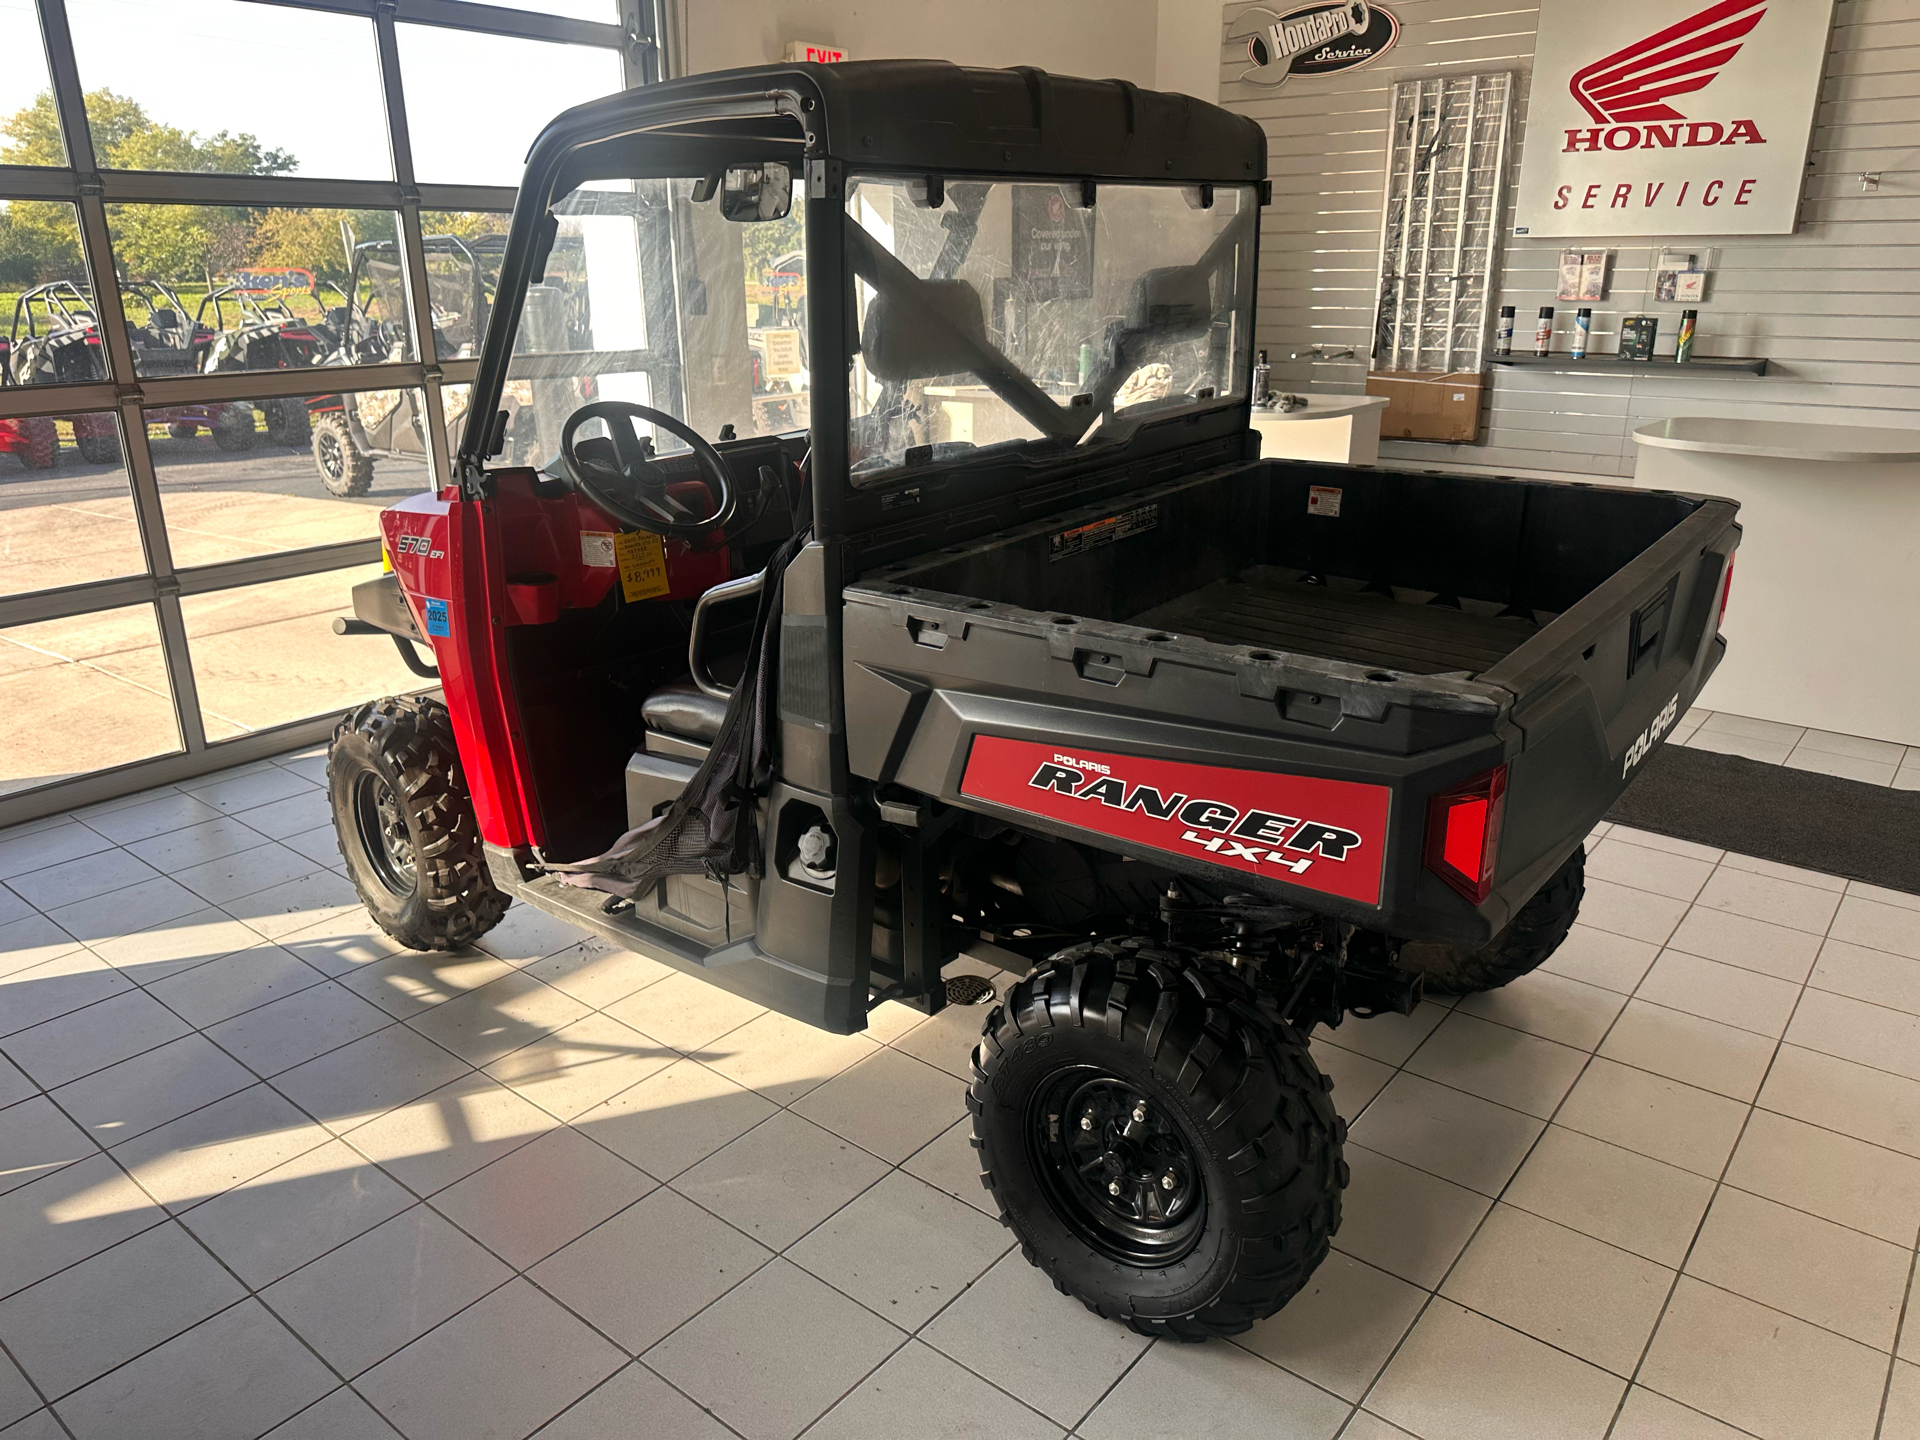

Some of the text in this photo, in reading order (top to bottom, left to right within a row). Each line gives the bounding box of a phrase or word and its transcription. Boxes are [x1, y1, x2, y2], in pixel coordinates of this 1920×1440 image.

[1268, 11, 1349, 60] HondaPro
[1314, 44, 1373, 61] Service
[1562, 119, 1767, 153] HONDA
[1553, 179, 1757, 210] SERVICE
[1031, 228, 1060, 239] Covered
[267, 283, 312, 303] Sports
[397, 535, 445, 560] 570 EFI
[626, 566, 661, 583] $8,999
[427, 610, 448, 623] 2025
[1621, 692, 1679, 780] POLARIS
[1053, 753, 1111, 776] POLARIS
[1028, 761, 1363, 862] RANGER
